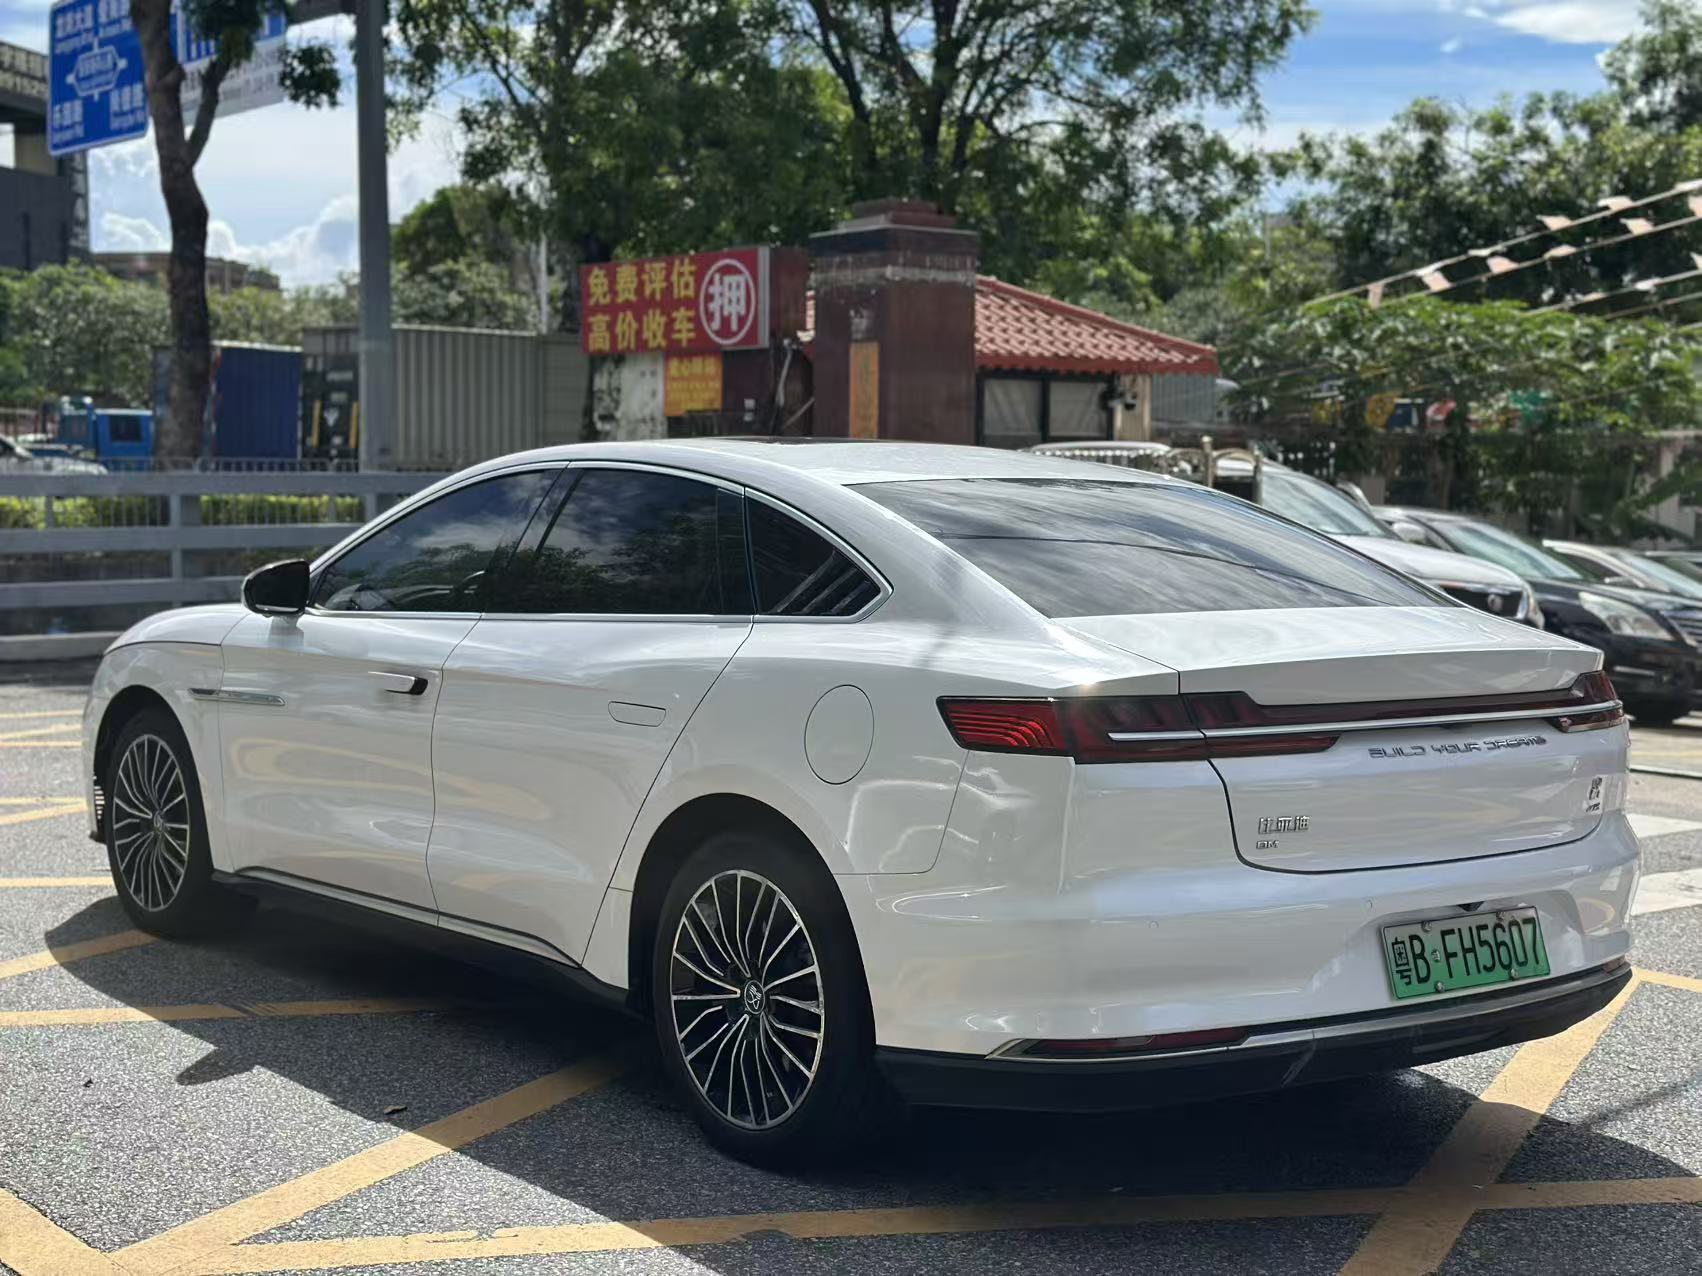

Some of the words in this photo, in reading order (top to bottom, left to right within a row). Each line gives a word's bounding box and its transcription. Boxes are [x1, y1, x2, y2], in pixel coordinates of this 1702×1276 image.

[587, 259, 697, 305] 免费评估
[708, 274, 748, 333] 押
[588, 309, 697, 351] 高价收车
[1368, 745, 1426, 758] BUILD
[1430, 743, 1482, 754] YOUR
[1258, 815, 1311, 834] 比亚迪
